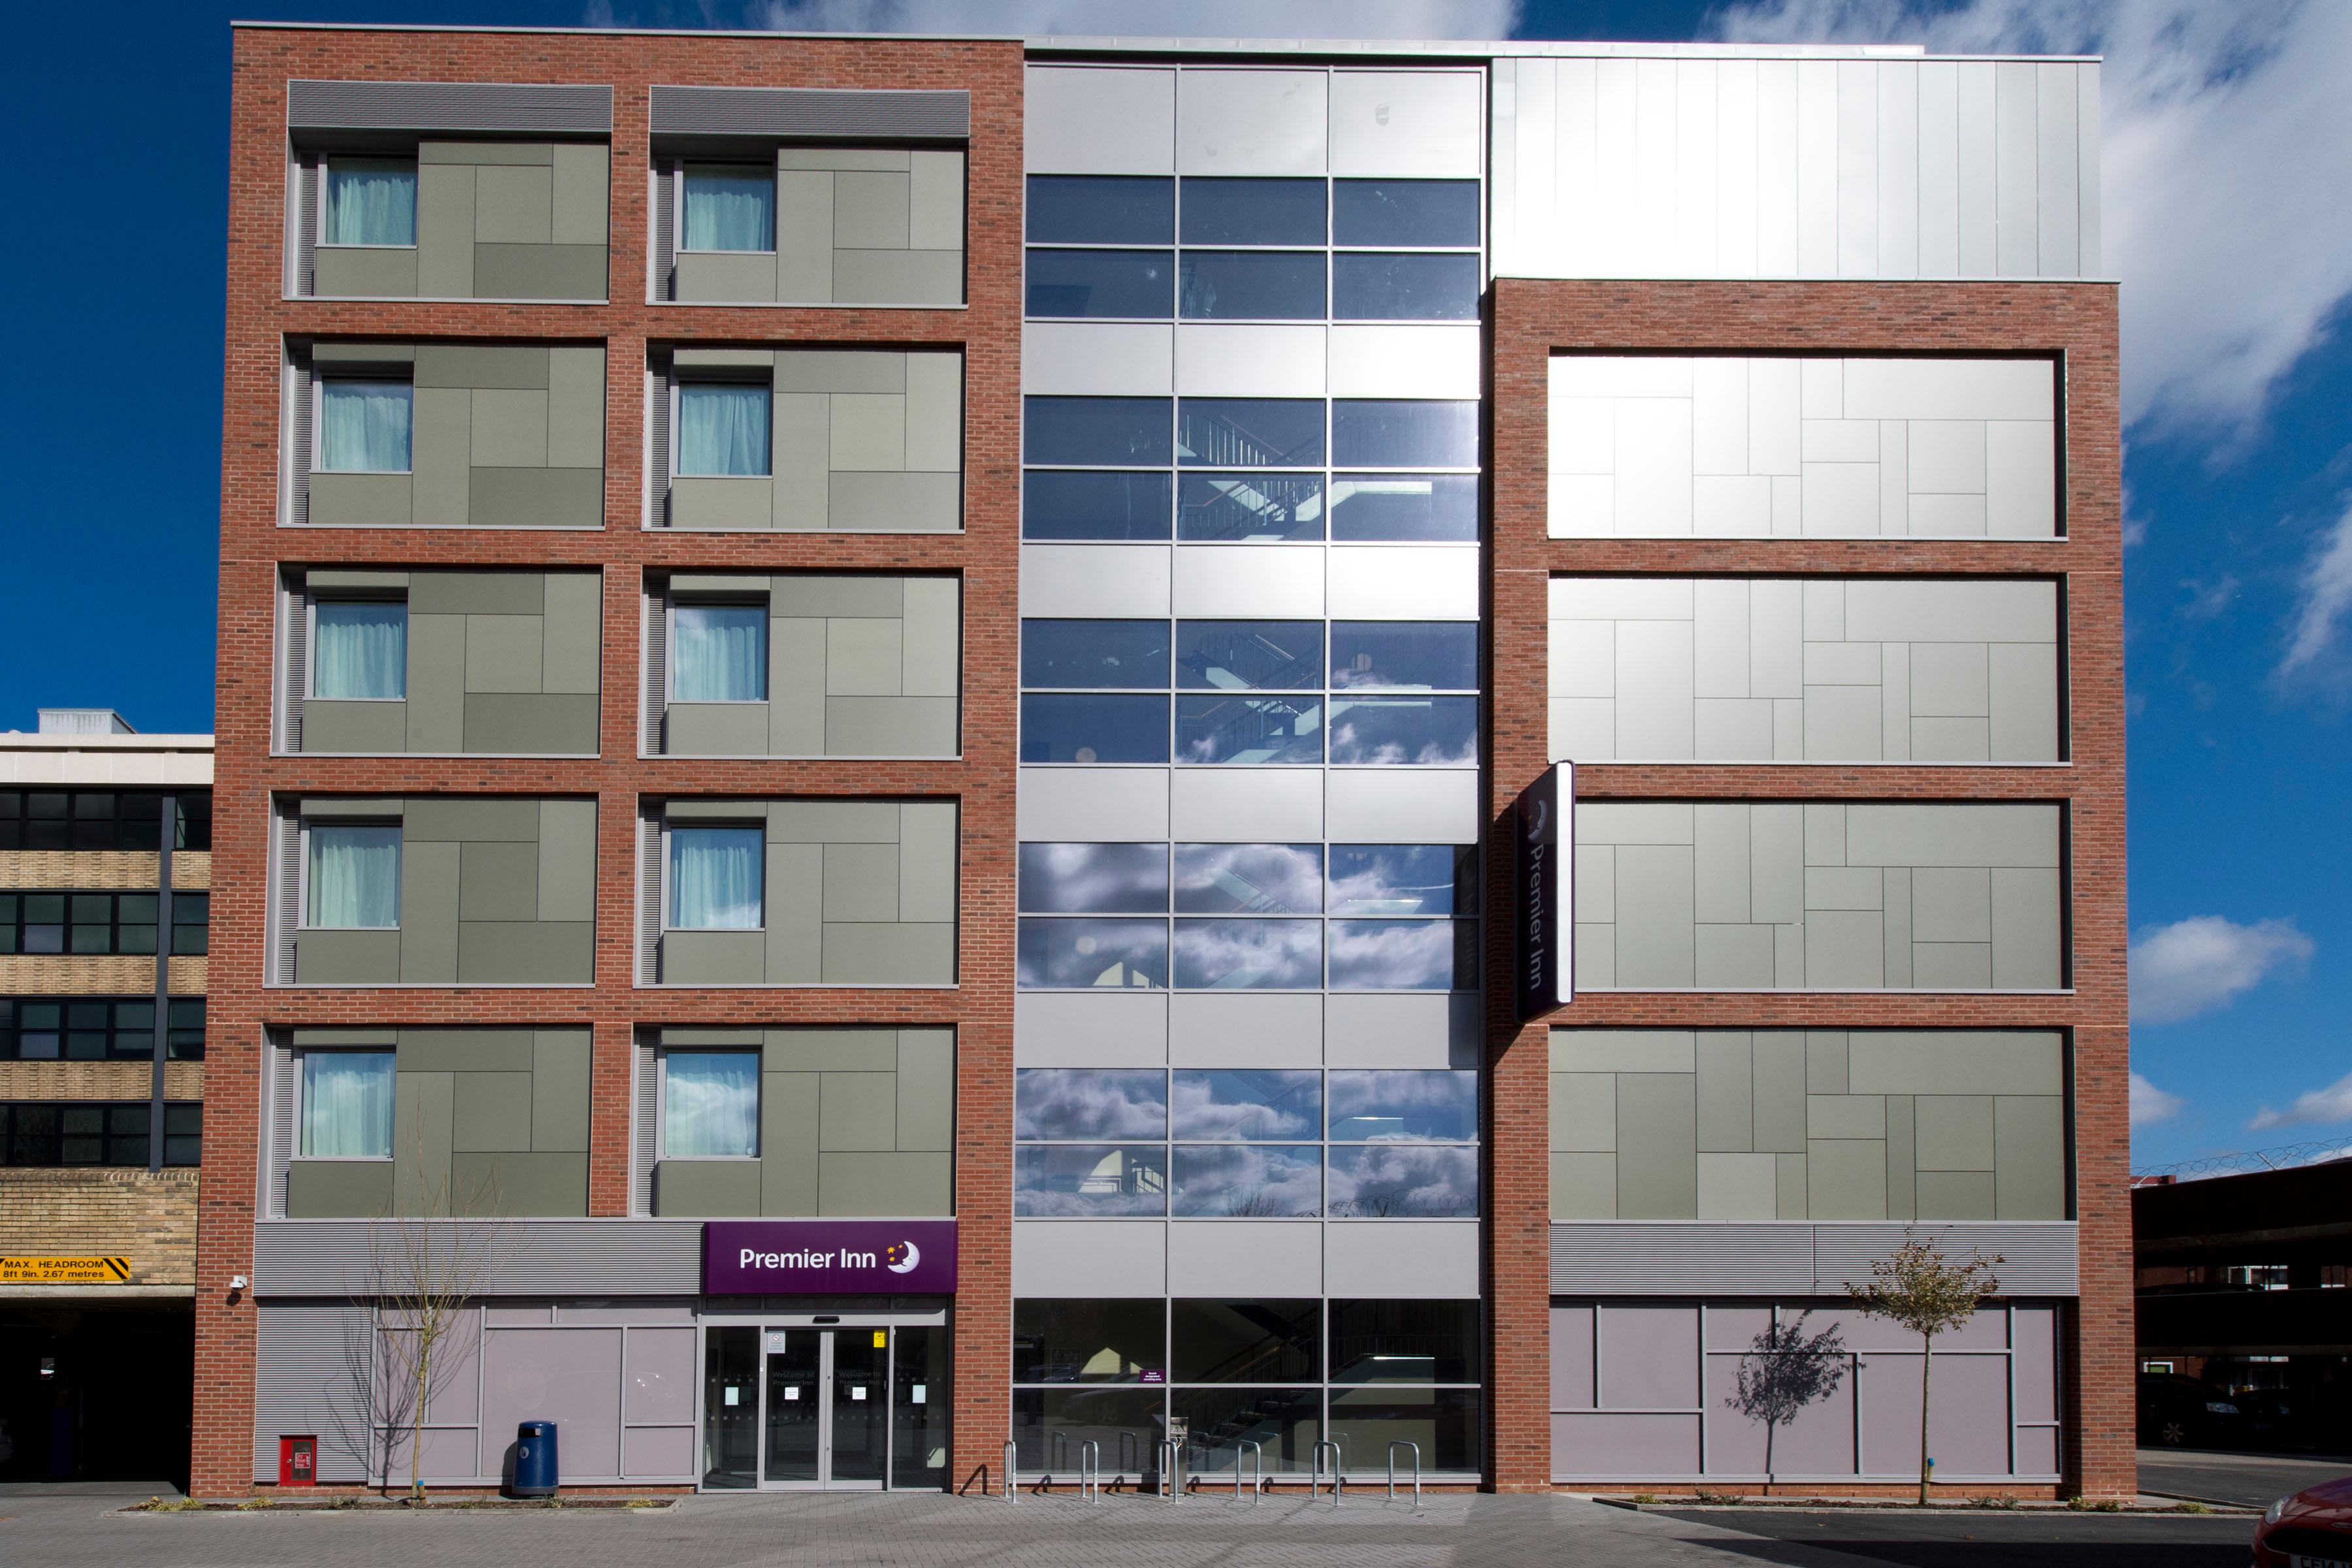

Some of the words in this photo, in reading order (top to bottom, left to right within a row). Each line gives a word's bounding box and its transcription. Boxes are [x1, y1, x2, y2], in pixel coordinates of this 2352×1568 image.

[1530, 843, 1544, 944] Premier
[1530, 948, 1544, 990] Inn
[740, 1249, 835, 1269] Premier
[841, 1248, 876, 1268] Inn
